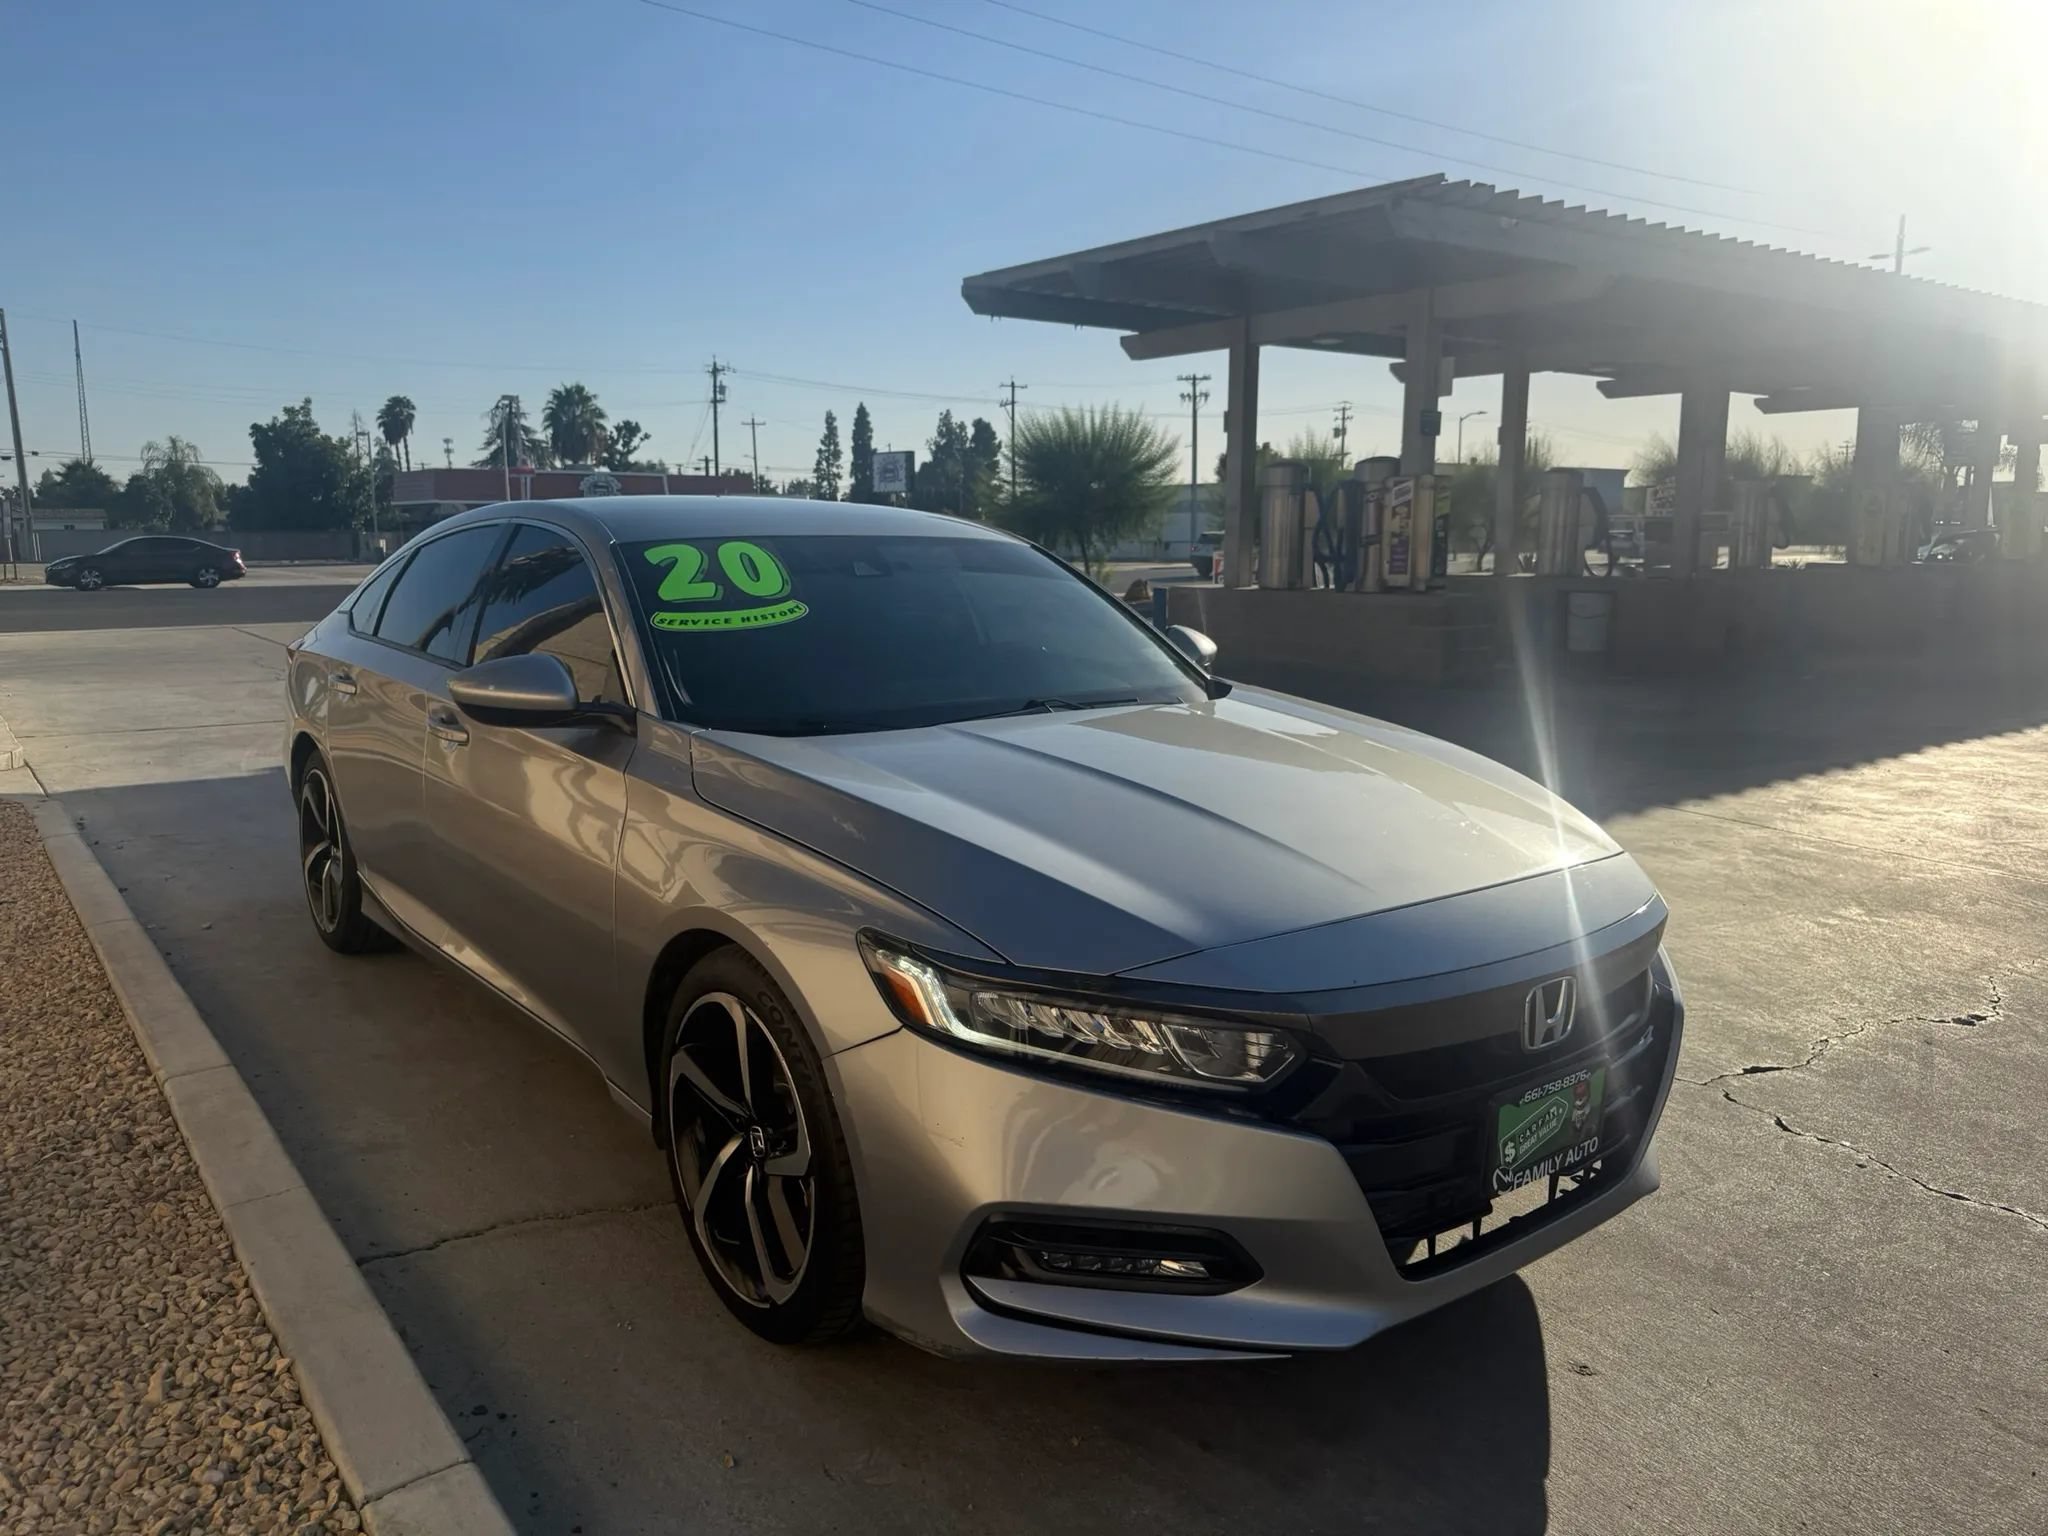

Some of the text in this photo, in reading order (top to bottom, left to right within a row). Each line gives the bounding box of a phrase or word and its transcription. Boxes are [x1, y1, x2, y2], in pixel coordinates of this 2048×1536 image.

[644, 541, 791, 602] 20
[656, 604, 803, 626] SERVICE HISTORY
[1519, 1118, 1558, 1154] GREAT VALUE
[1513, 1136, 1598, 1190] FAMILY AUTO
